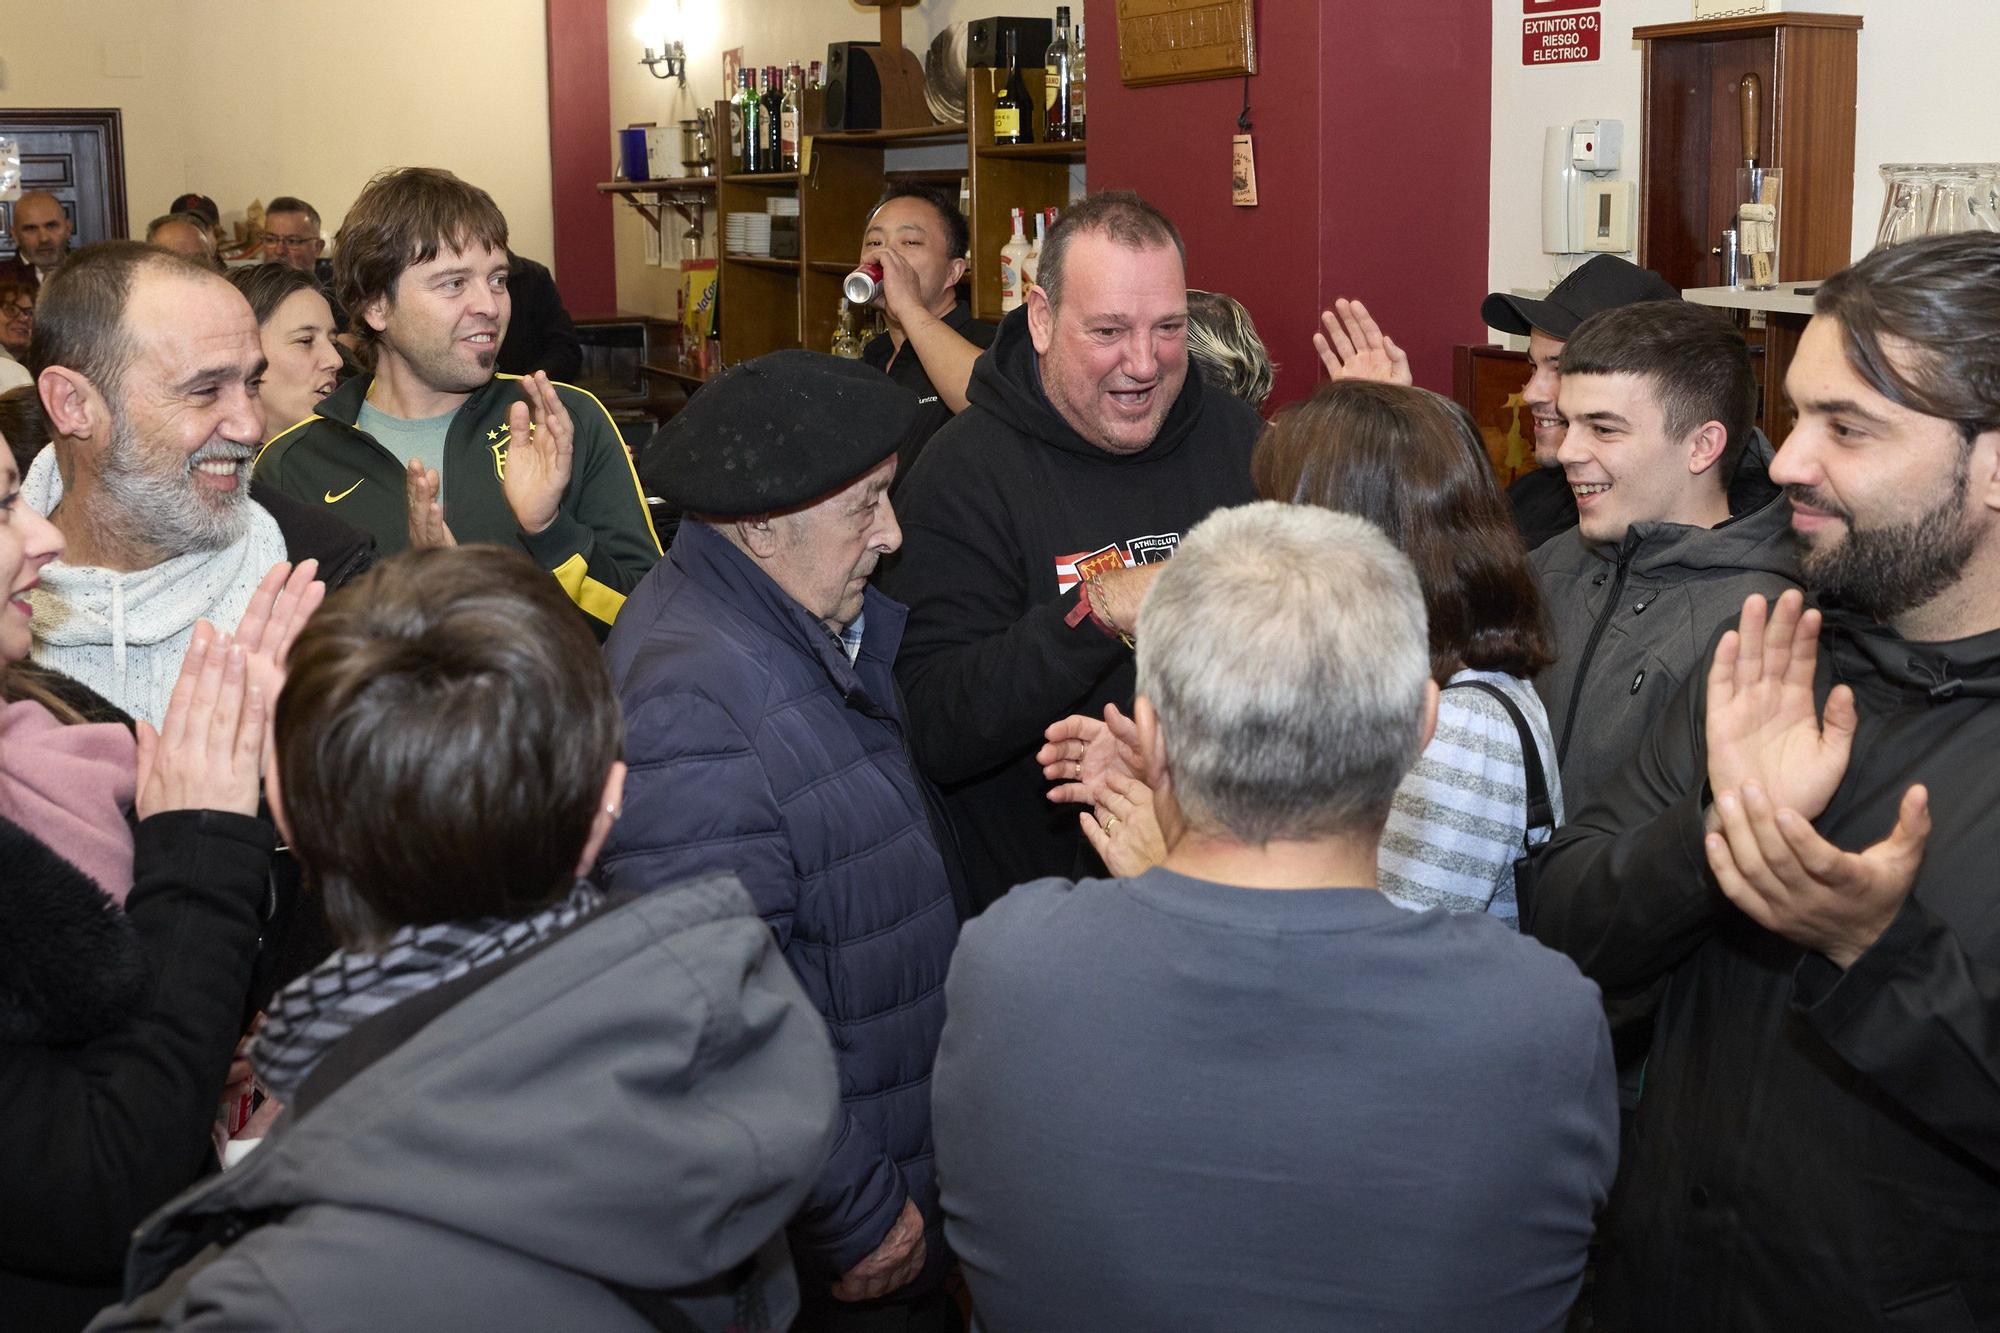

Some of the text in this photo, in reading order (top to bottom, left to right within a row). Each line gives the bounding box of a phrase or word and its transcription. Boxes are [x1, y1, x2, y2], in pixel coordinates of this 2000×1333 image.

[1524, 18, 1576, 34] EXTINTOR
[1542, 33, 1579, 47] RIESGO
[1533, 46, 1588, 61] ELECTRICO
[1157, 536, 1177, 546] CLUB
